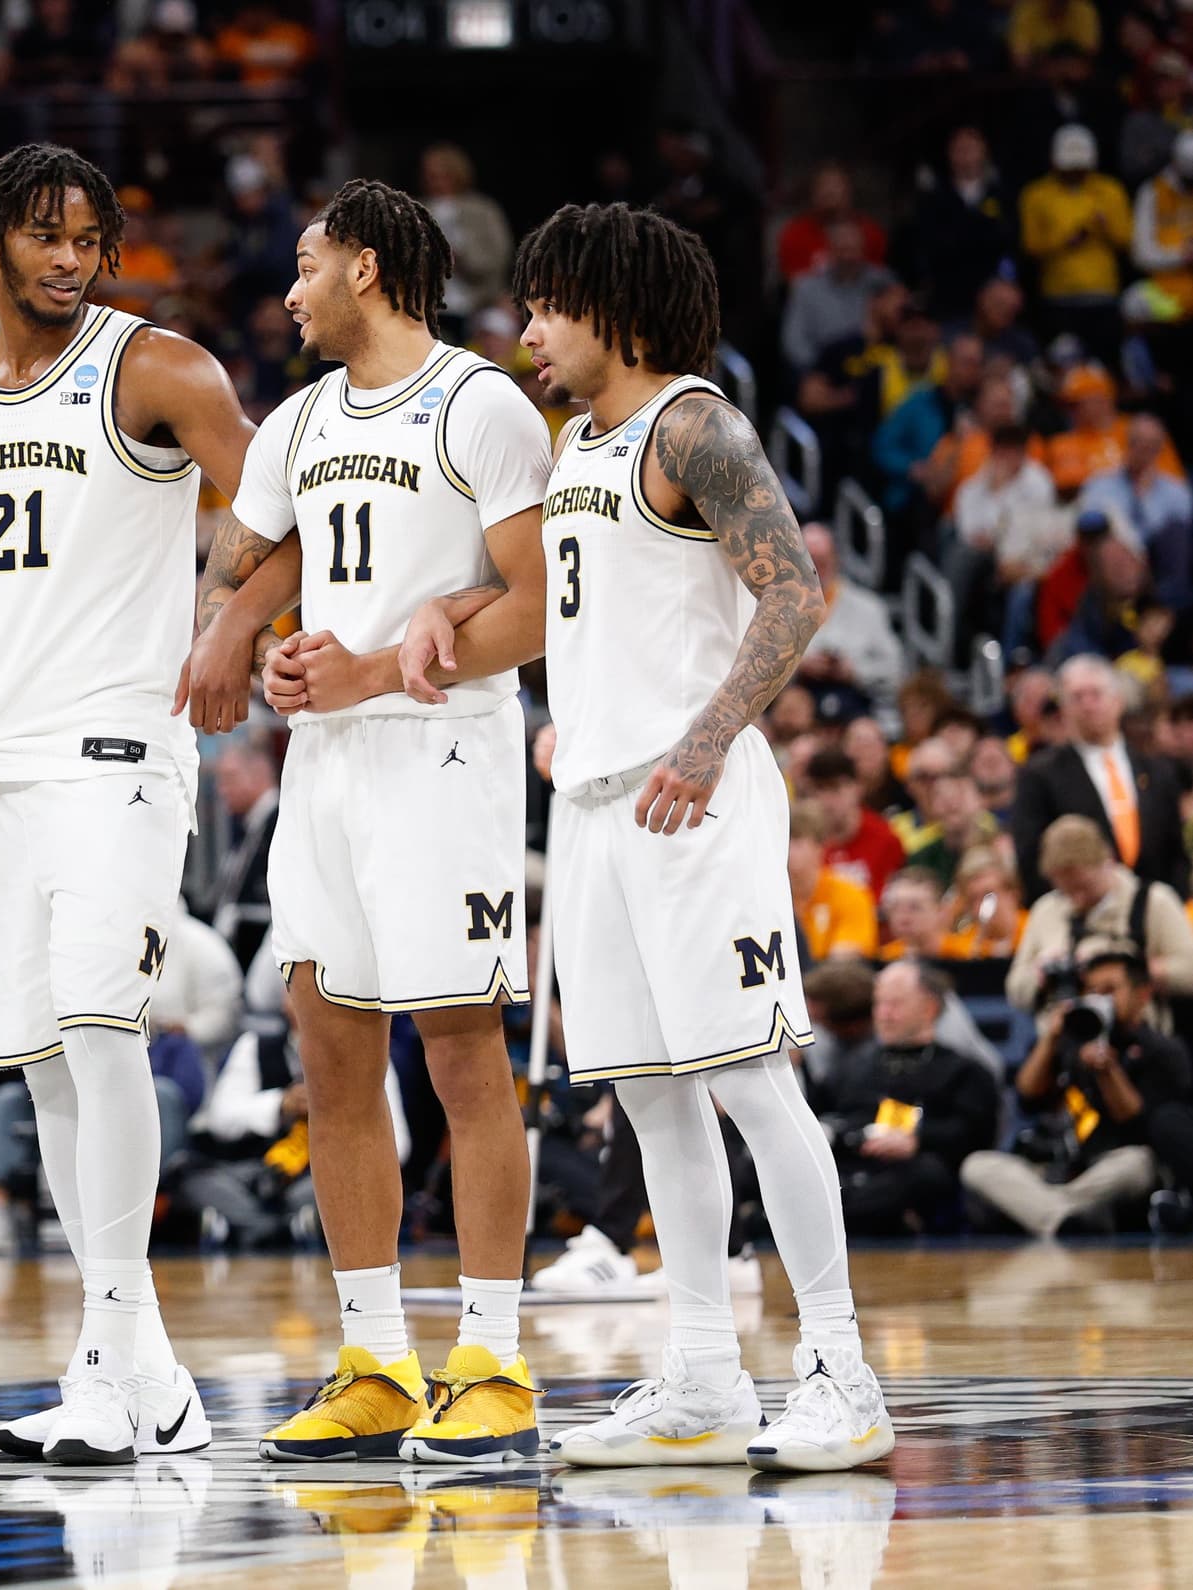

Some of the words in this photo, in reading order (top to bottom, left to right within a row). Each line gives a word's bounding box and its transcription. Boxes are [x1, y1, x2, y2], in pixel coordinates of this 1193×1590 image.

[297, 454, 421, 496] MICHIGAN
[328, 502, 373, 583] 11
[559, 536, 581, 620] 3
[129, 745, 141, 755] 50
[465, 889, 514, 942] M
[731, 929, 786, 990] M
